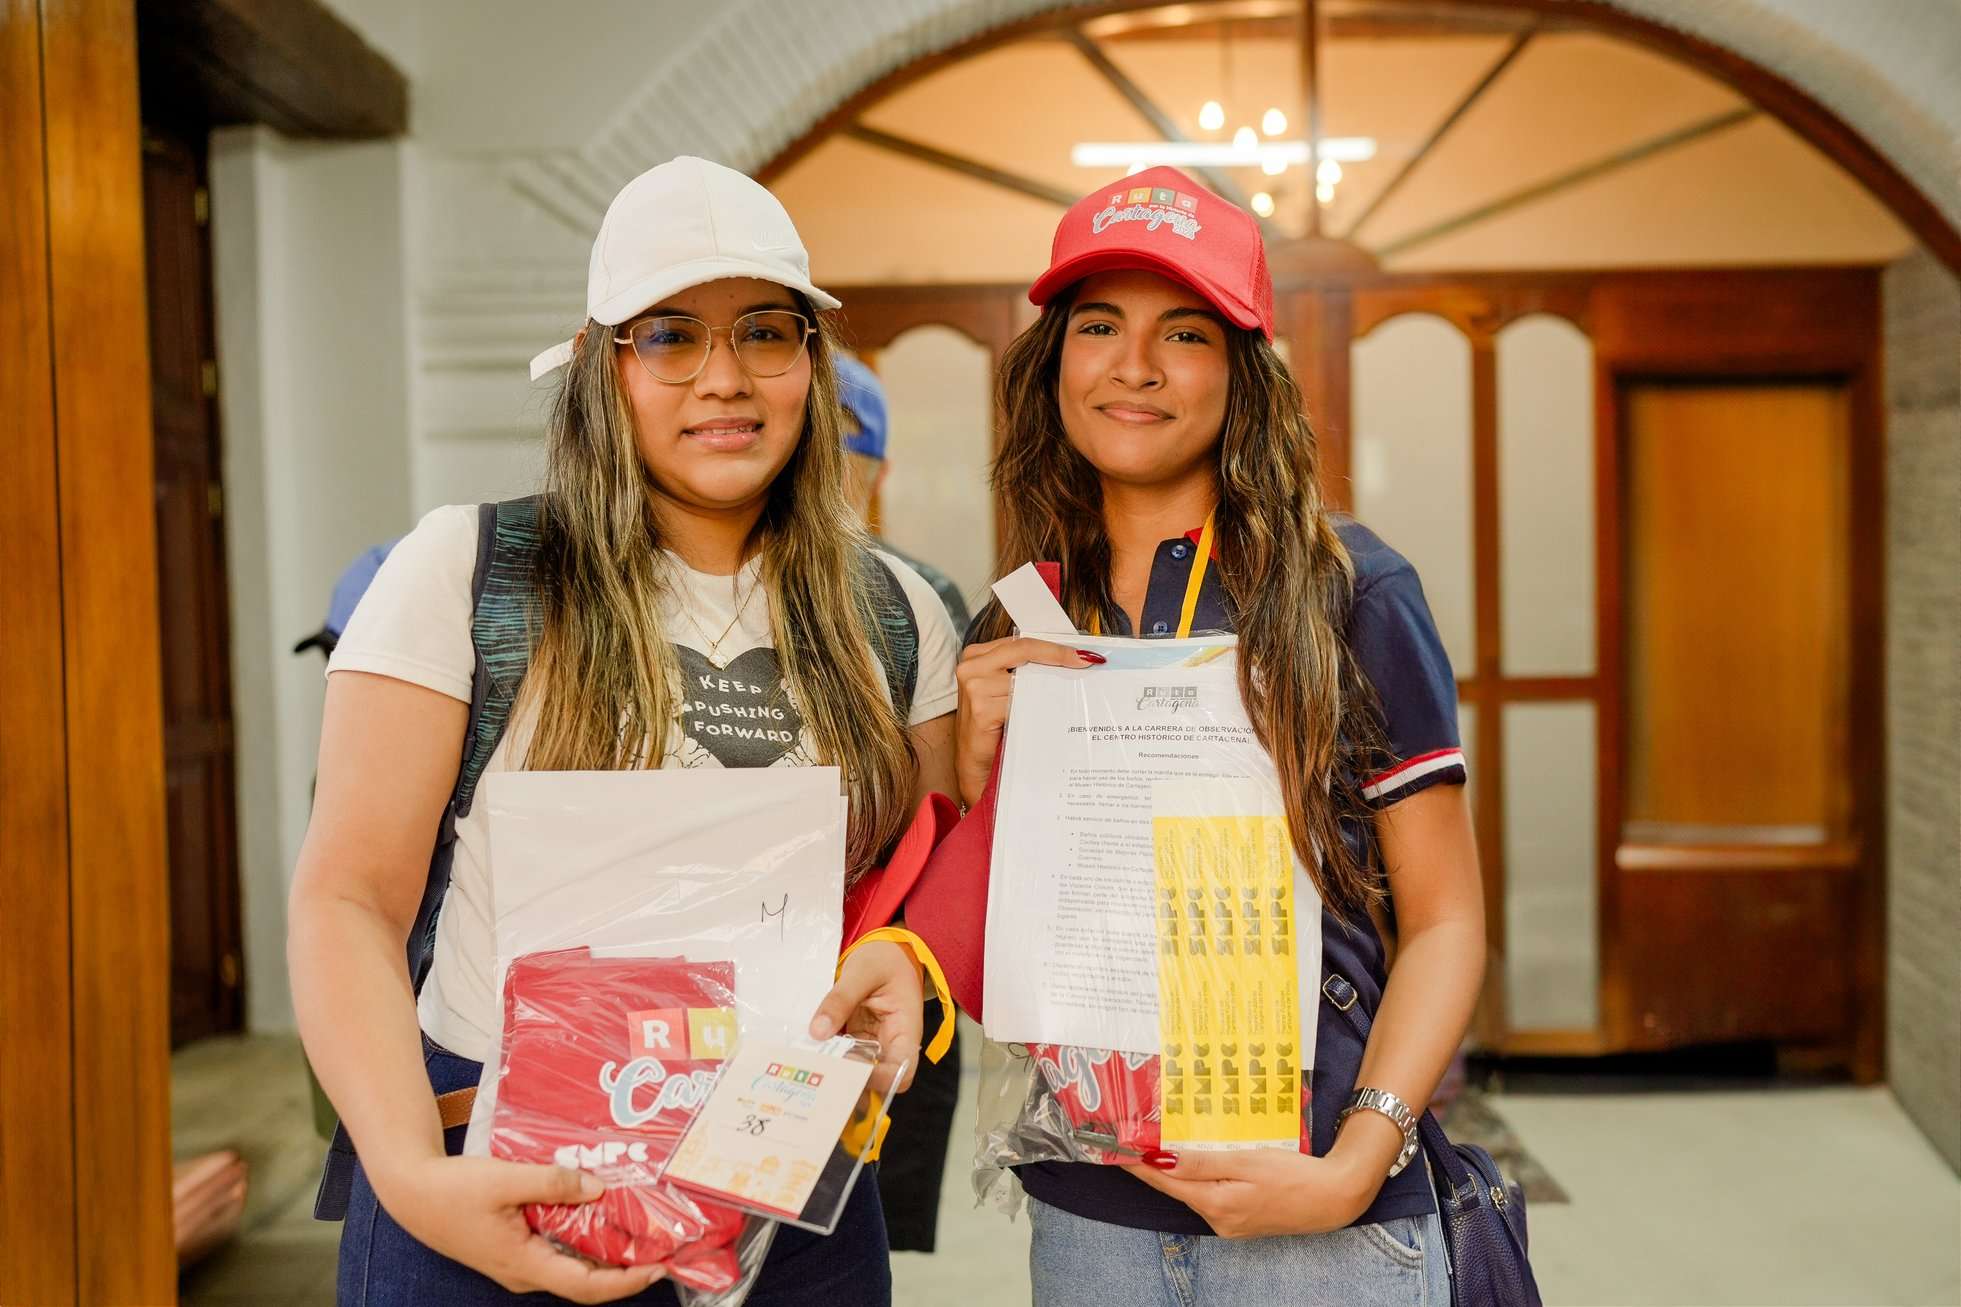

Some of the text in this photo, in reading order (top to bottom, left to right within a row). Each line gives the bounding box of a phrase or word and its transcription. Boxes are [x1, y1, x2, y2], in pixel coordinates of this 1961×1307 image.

[1110, 190, 1193, 209] Ruta
[1093, 205, 1201, 233] Cartagena
[699, 674, 762, 694] KEEP
[694, 701, 785, 720] PUSHING
[694, 721, 793, 742] FORWARD
[1138, 752, 1200, 760] Recomendaciones
[641, 1019, 727, 1049] Ru
